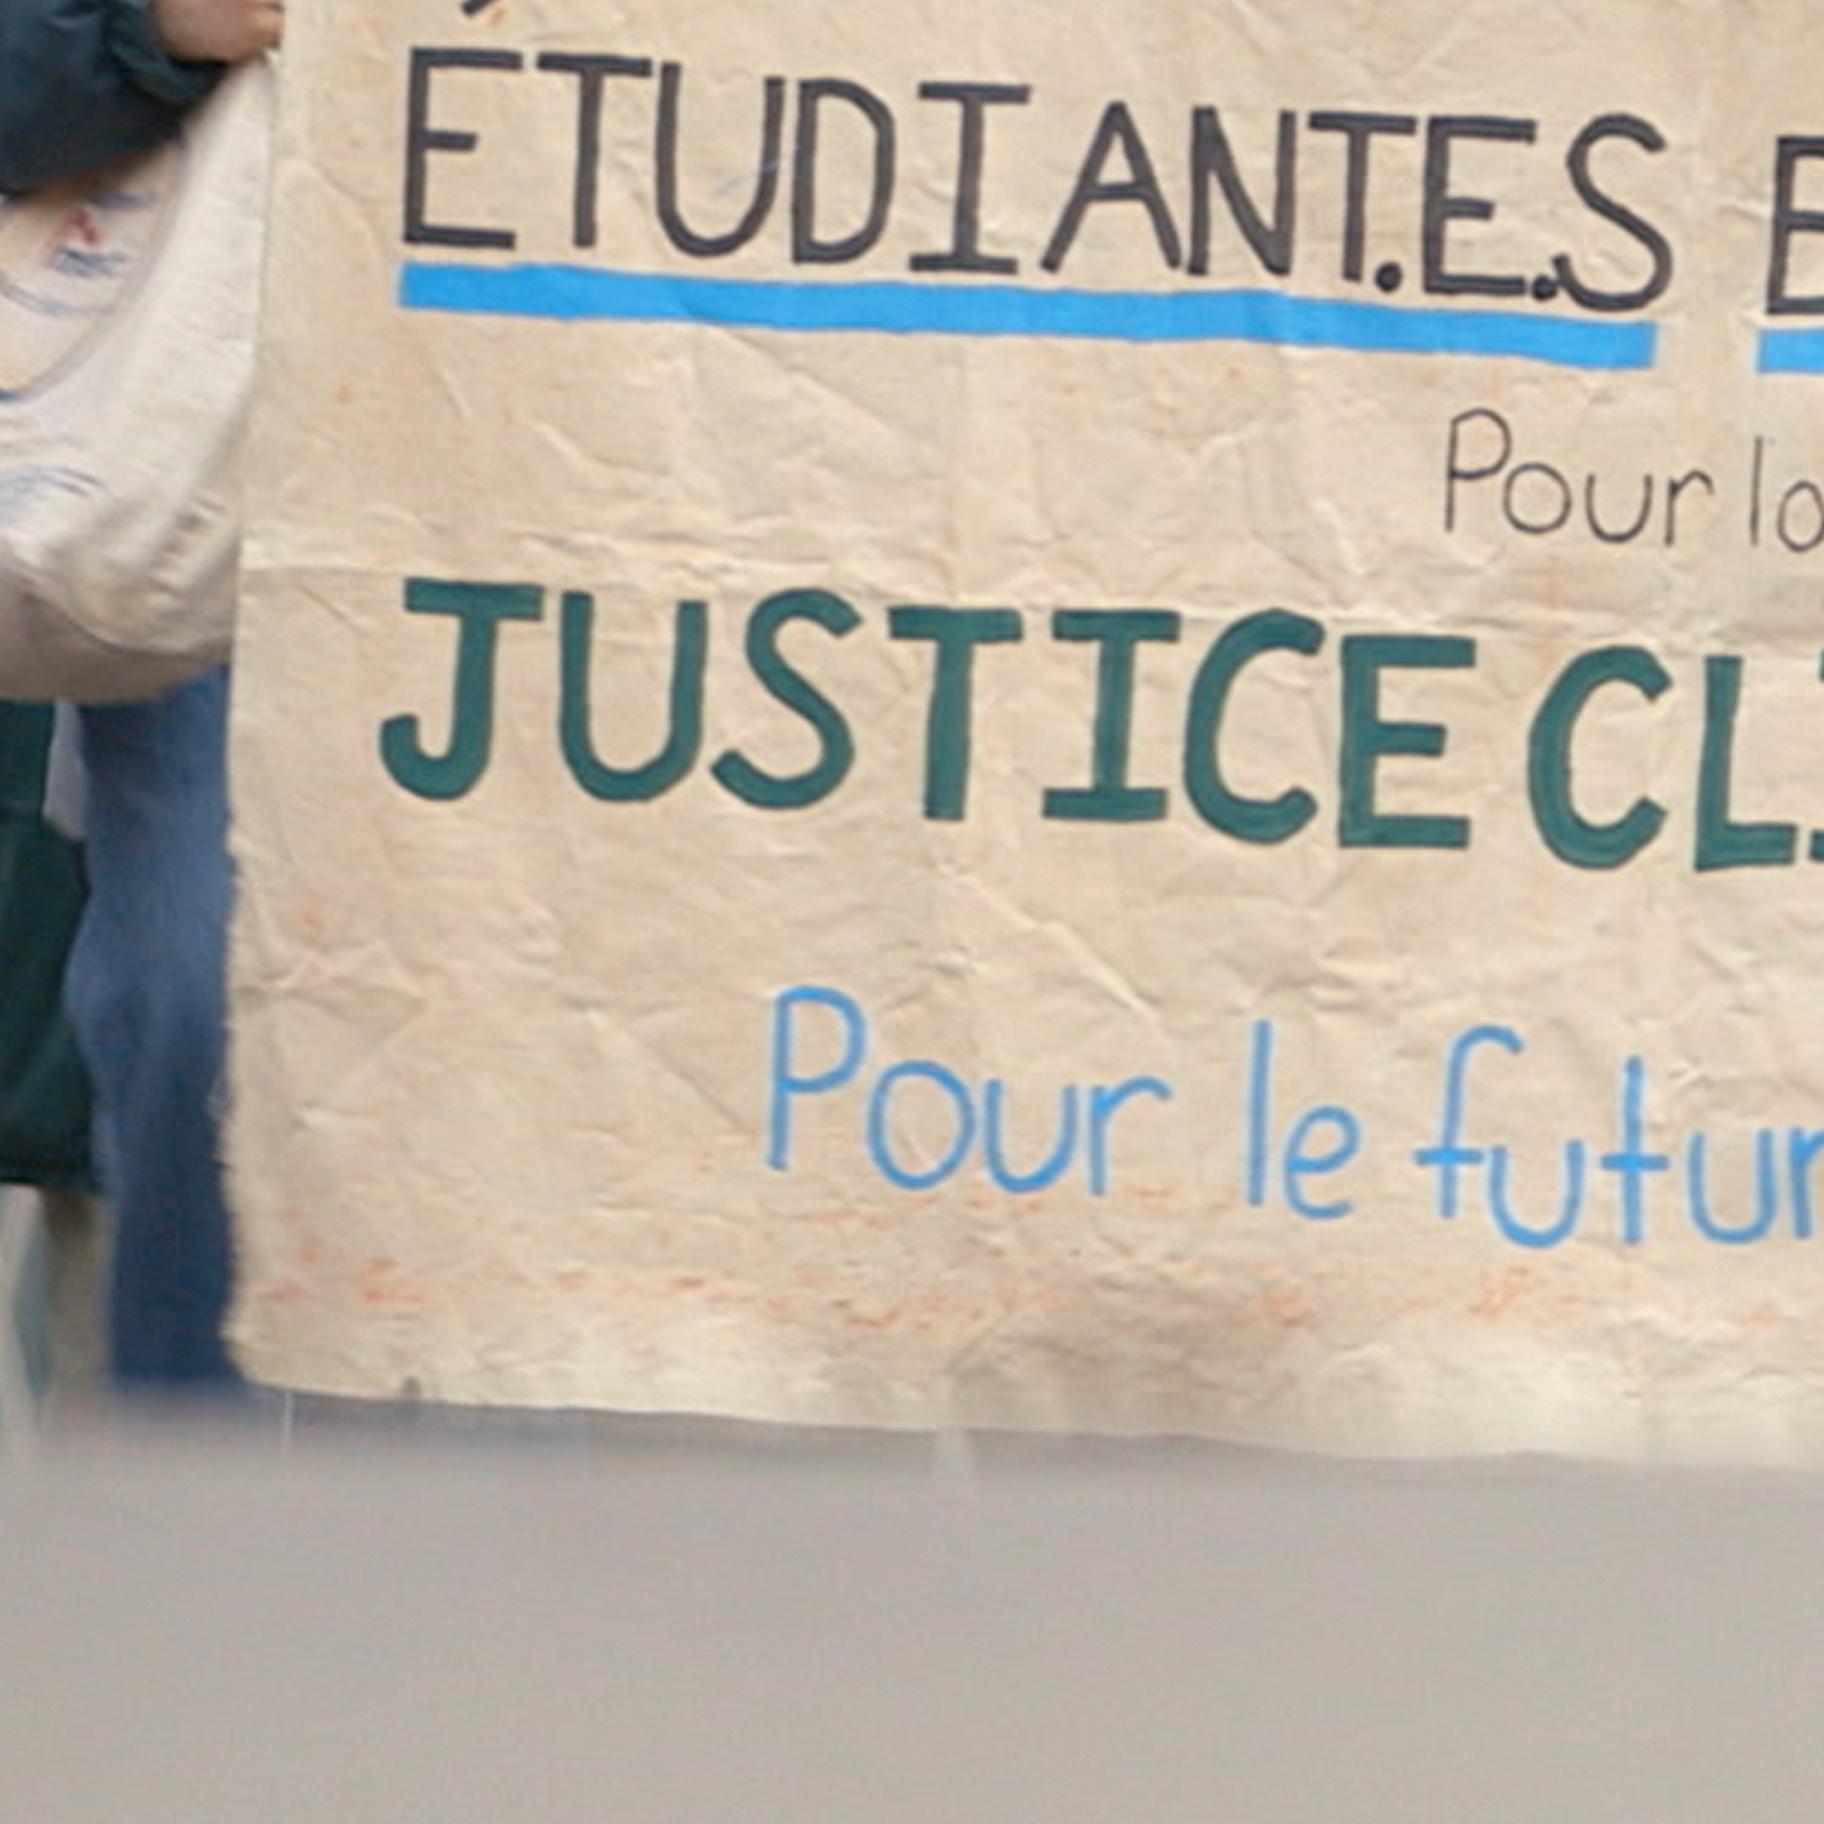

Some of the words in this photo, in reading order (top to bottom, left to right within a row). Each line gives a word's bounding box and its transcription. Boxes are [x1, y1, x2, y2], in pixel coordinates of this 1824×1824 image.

[1445, 408, 1715, 547] Pour
[379, 578, 1477, 848] JUSTICE
[766, 985, 1171, 1196] Pour
[1247, 1020, 1361, 1220] le
